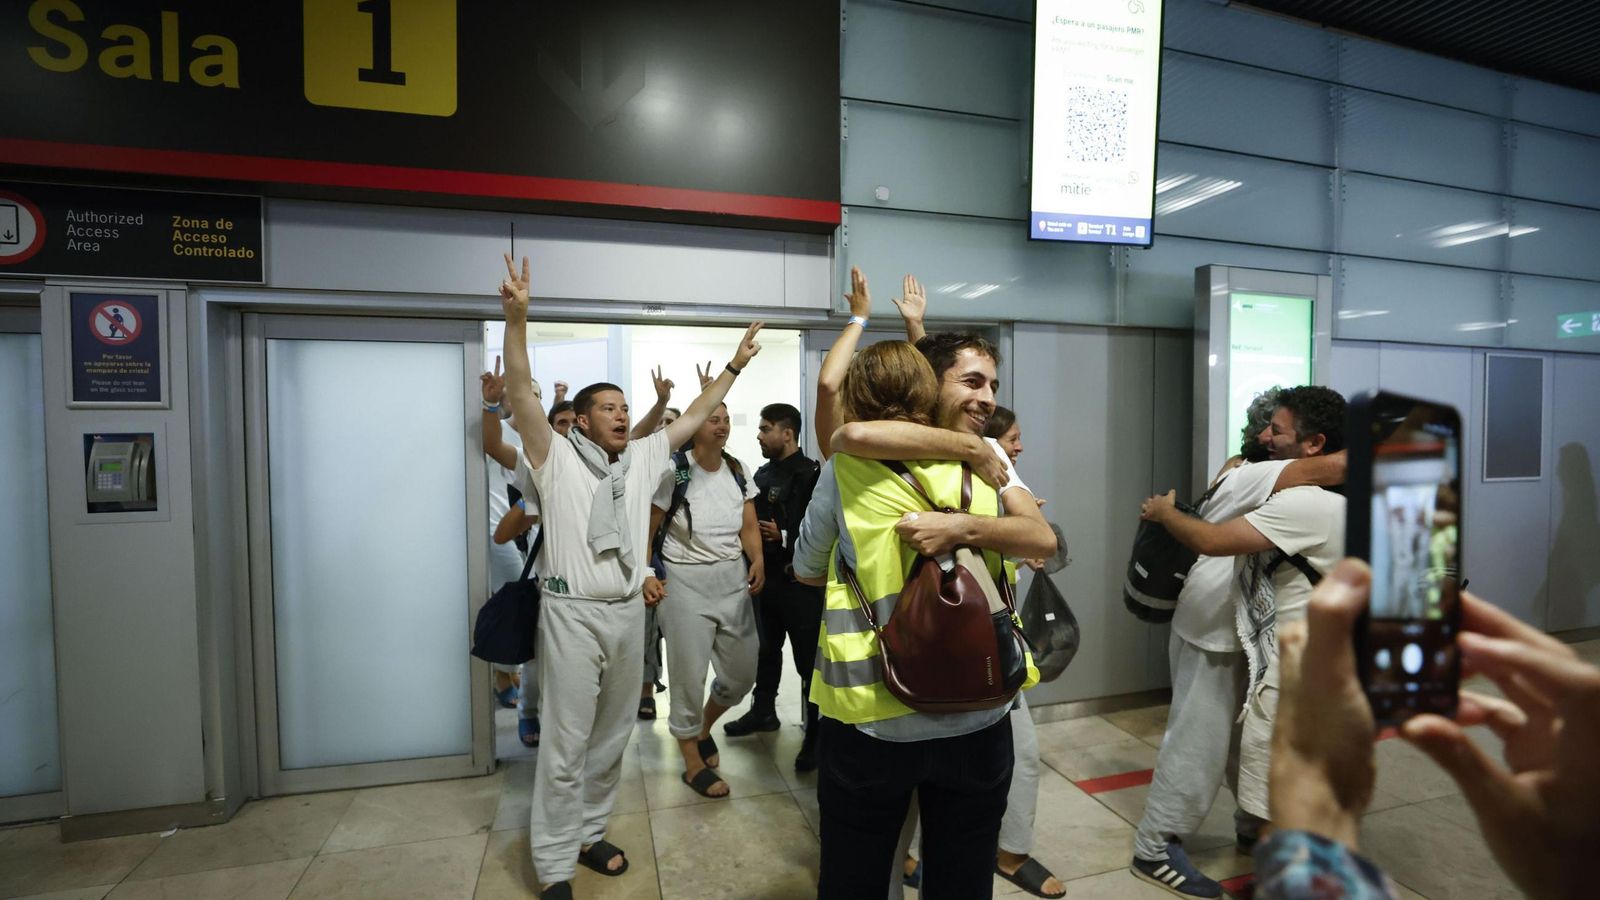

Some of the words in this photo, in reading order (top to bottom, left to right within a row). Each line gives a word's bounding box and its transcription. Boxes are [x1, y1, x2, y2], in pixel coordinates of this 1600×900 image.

[26, 0, 240, 89] Sala
[357, 0, 407, 86] 1
[1060, 182, 1092, 195] mitie
[66, 209, 144, 225] Authorized
[172, 215, 208, 229] Zona
[216, 218, 233, 230] de
[66, 224, 120, 238] Access
[172, 230, 227, 244] Acceso
[67, 238, 100, 252] Area
[173, 244, 255, 259] Controlado
